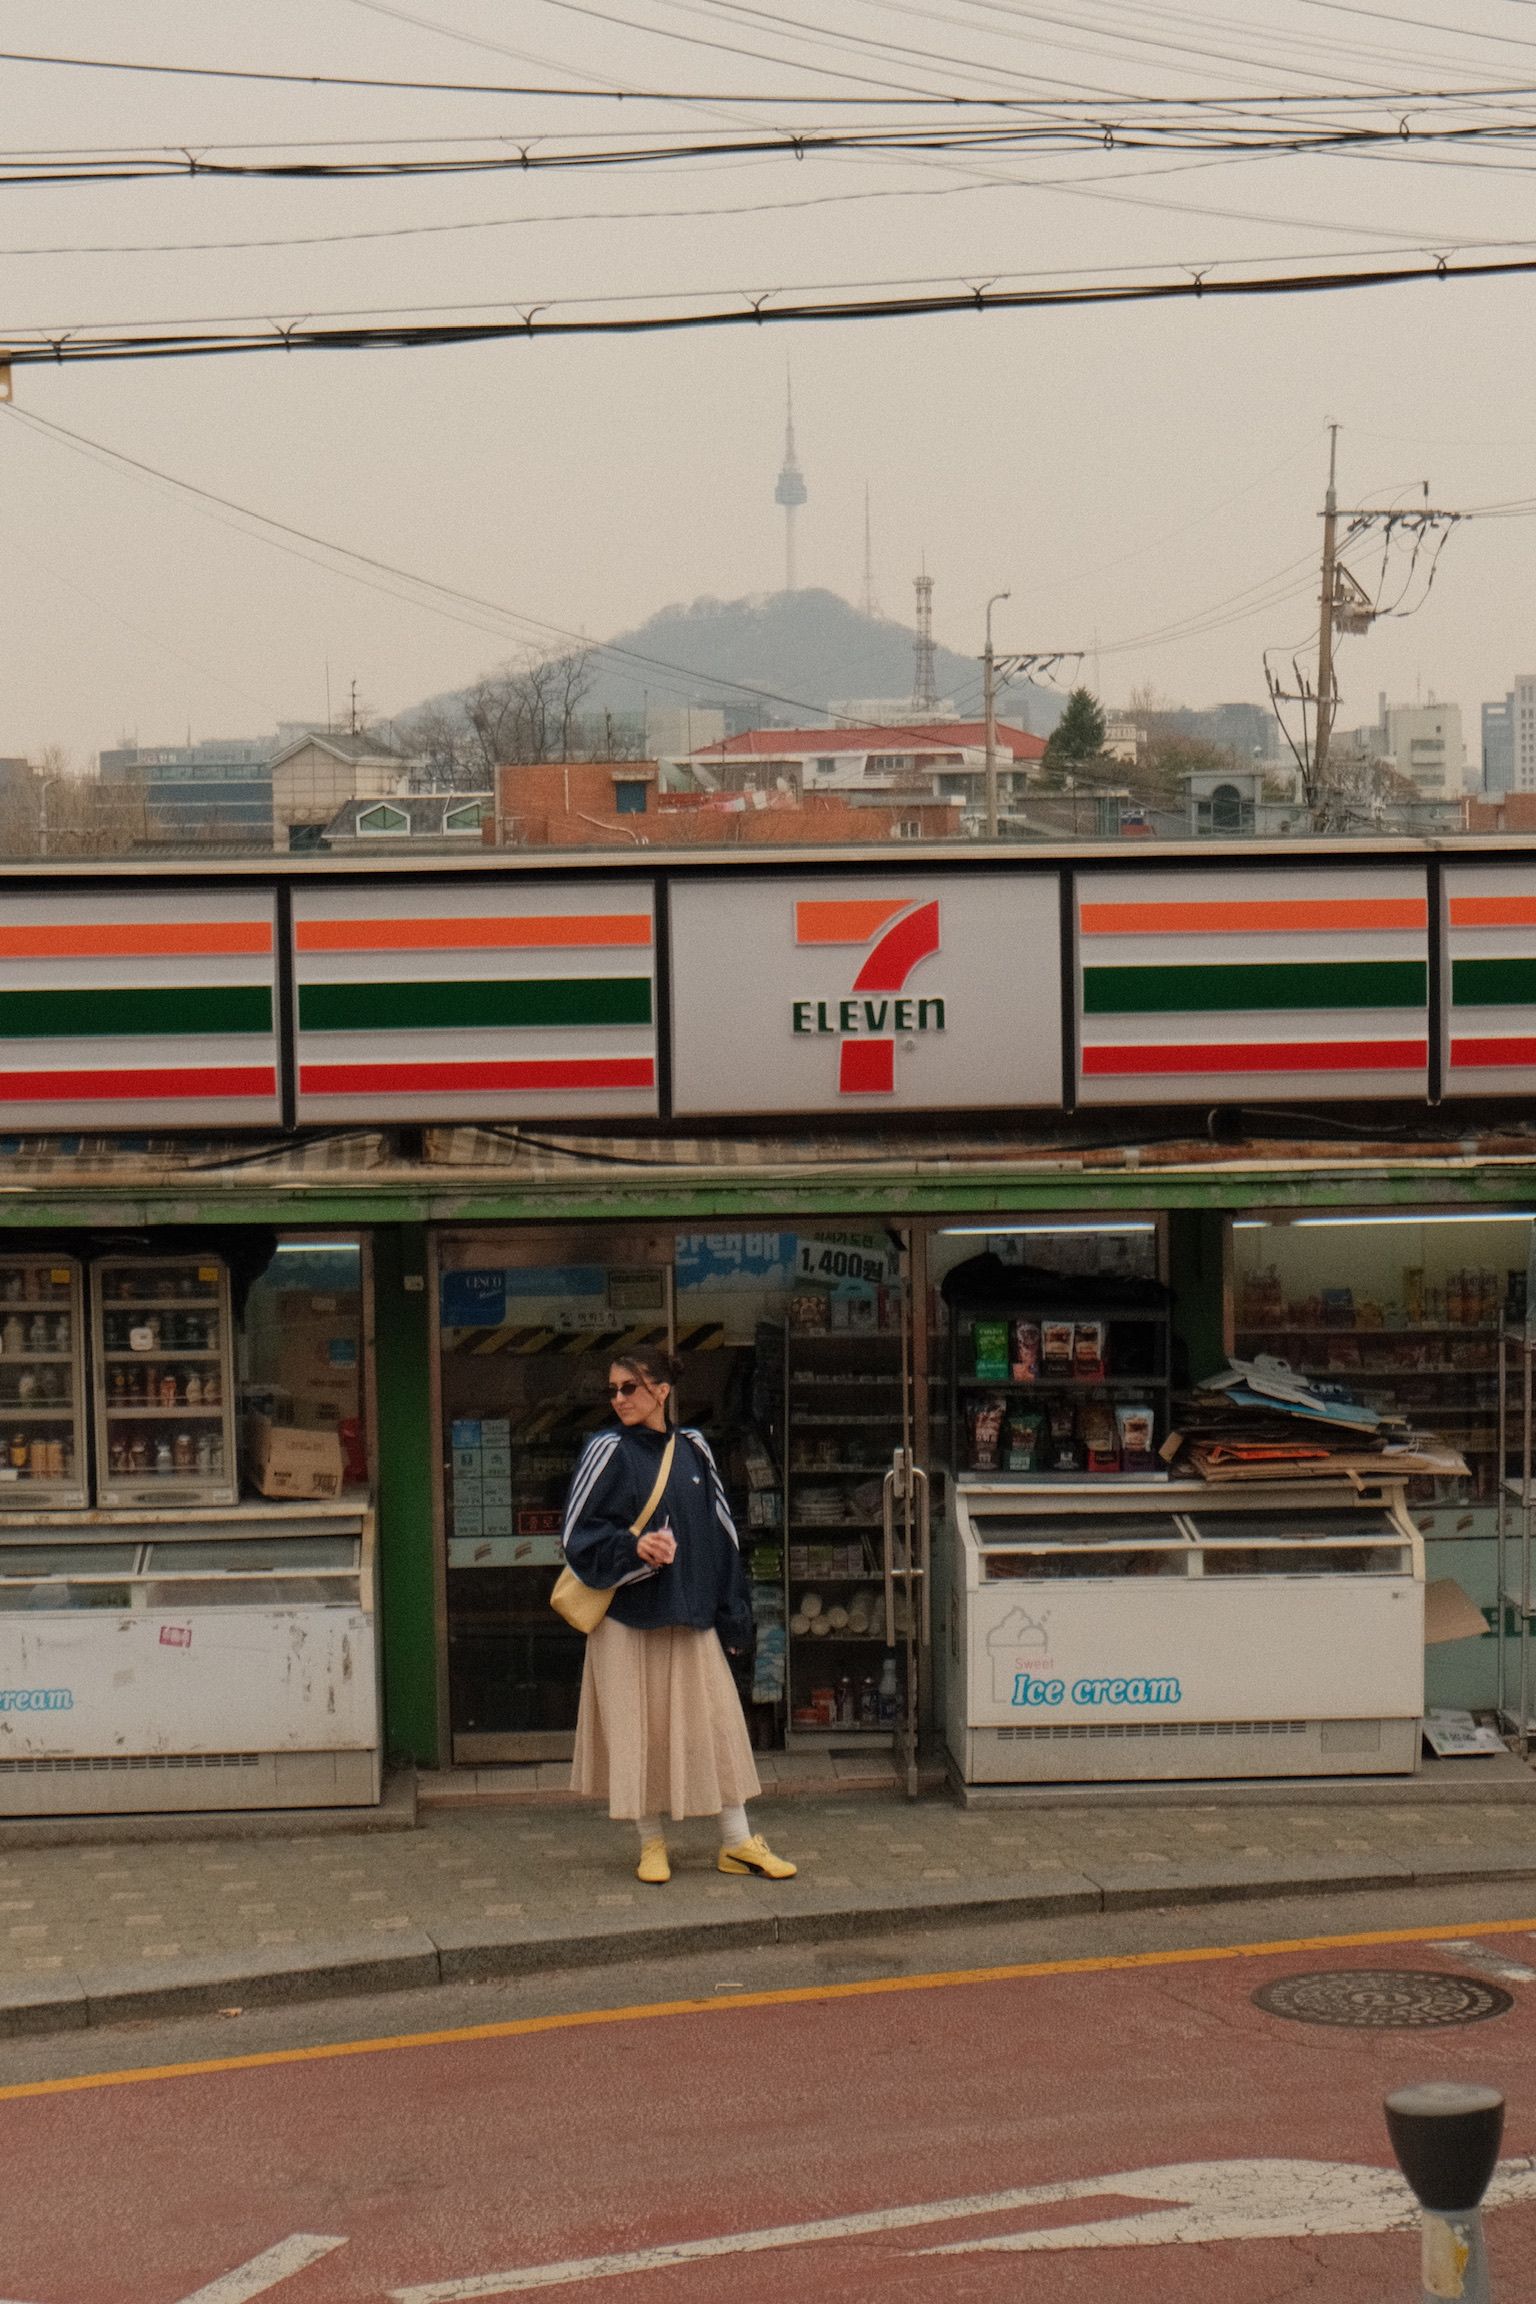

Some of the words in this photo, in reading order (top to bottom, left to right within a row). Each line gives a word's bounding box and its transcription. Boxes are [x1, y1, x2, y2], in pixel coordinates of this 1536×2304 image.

[796, 900, 940, 1093] 7
[802, 1247, 884, 1283] 1,400원
[1015, 1657, 1054, 1669] Sweet
[0, 1688, 74, 1711] ream
[1012, 1674, 1065, 1705] Ice
[1071, 1676, 1181, 1705] cream
